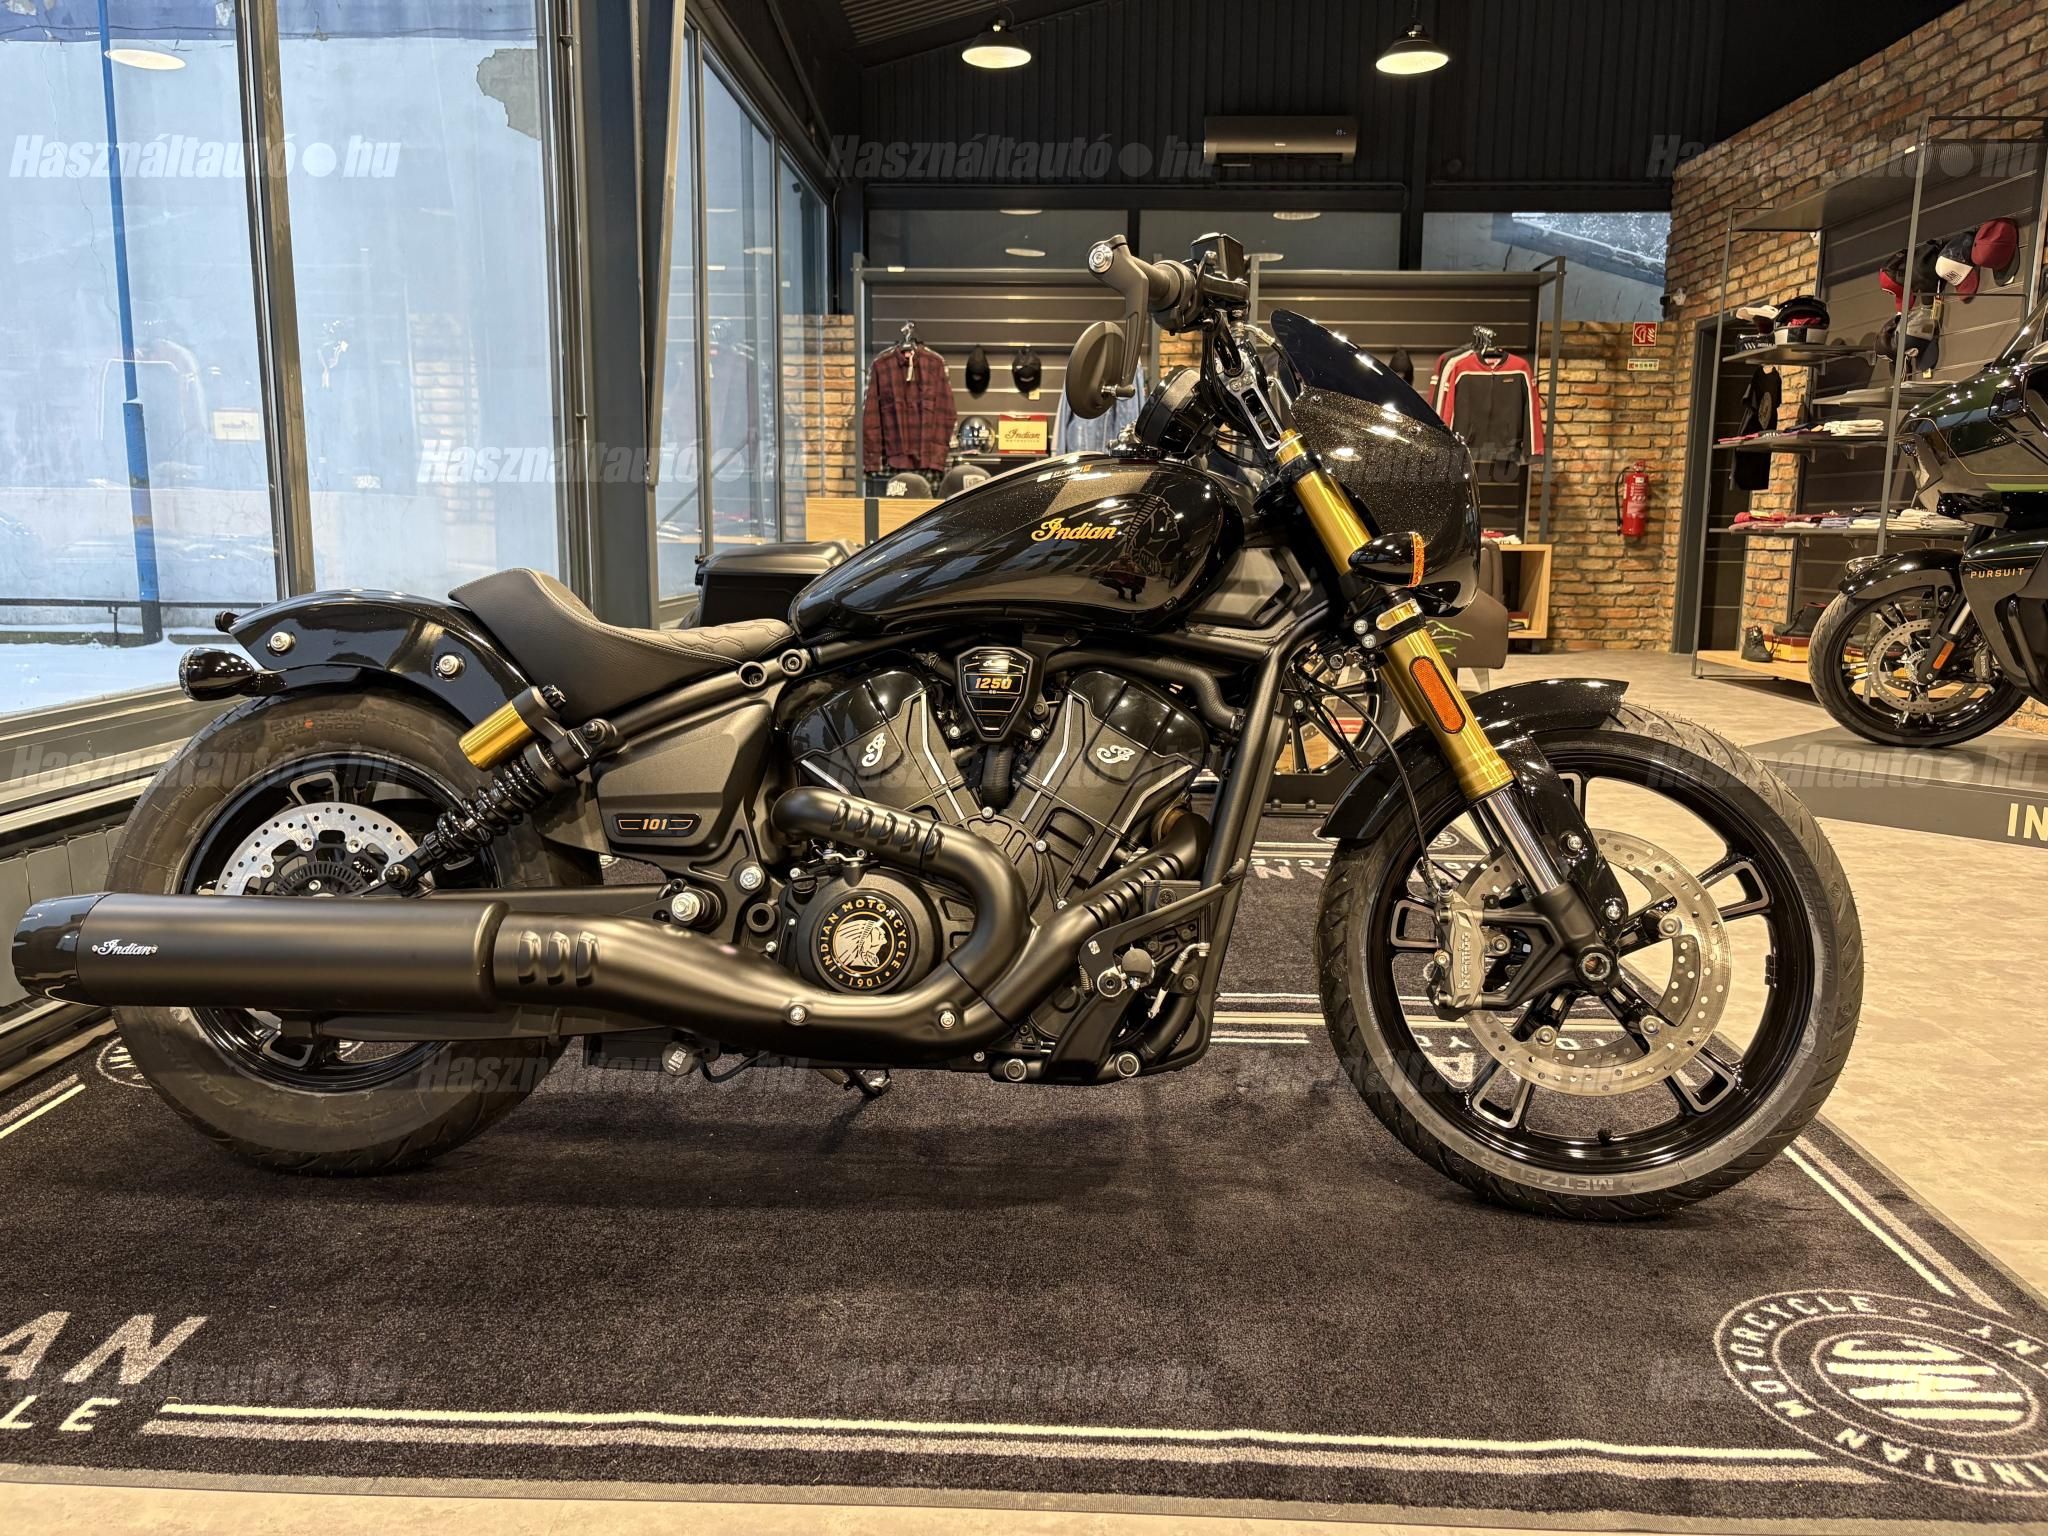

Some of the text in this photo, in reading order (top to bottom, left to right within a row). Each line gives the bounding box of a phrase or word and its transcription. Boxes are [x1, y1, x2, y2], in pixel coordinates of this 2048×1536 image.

[1004, 428, 1040, 440] Indian
[1031, 517, 1117, 542] Indian
[1970, 567, 2025, 579] PURSUIT
[975, 677, 1013, 690] 1250
[642, 818, 668, 831] 101
[2007, 803, 2048, 842] IN
[820, 899, 907, 973] INDIAN MOTORCYCLE
[97, 939, 152, 956] Indian
[1457, 931, 1471, 989] brembo
[848, 975, 882, 988] 1901
